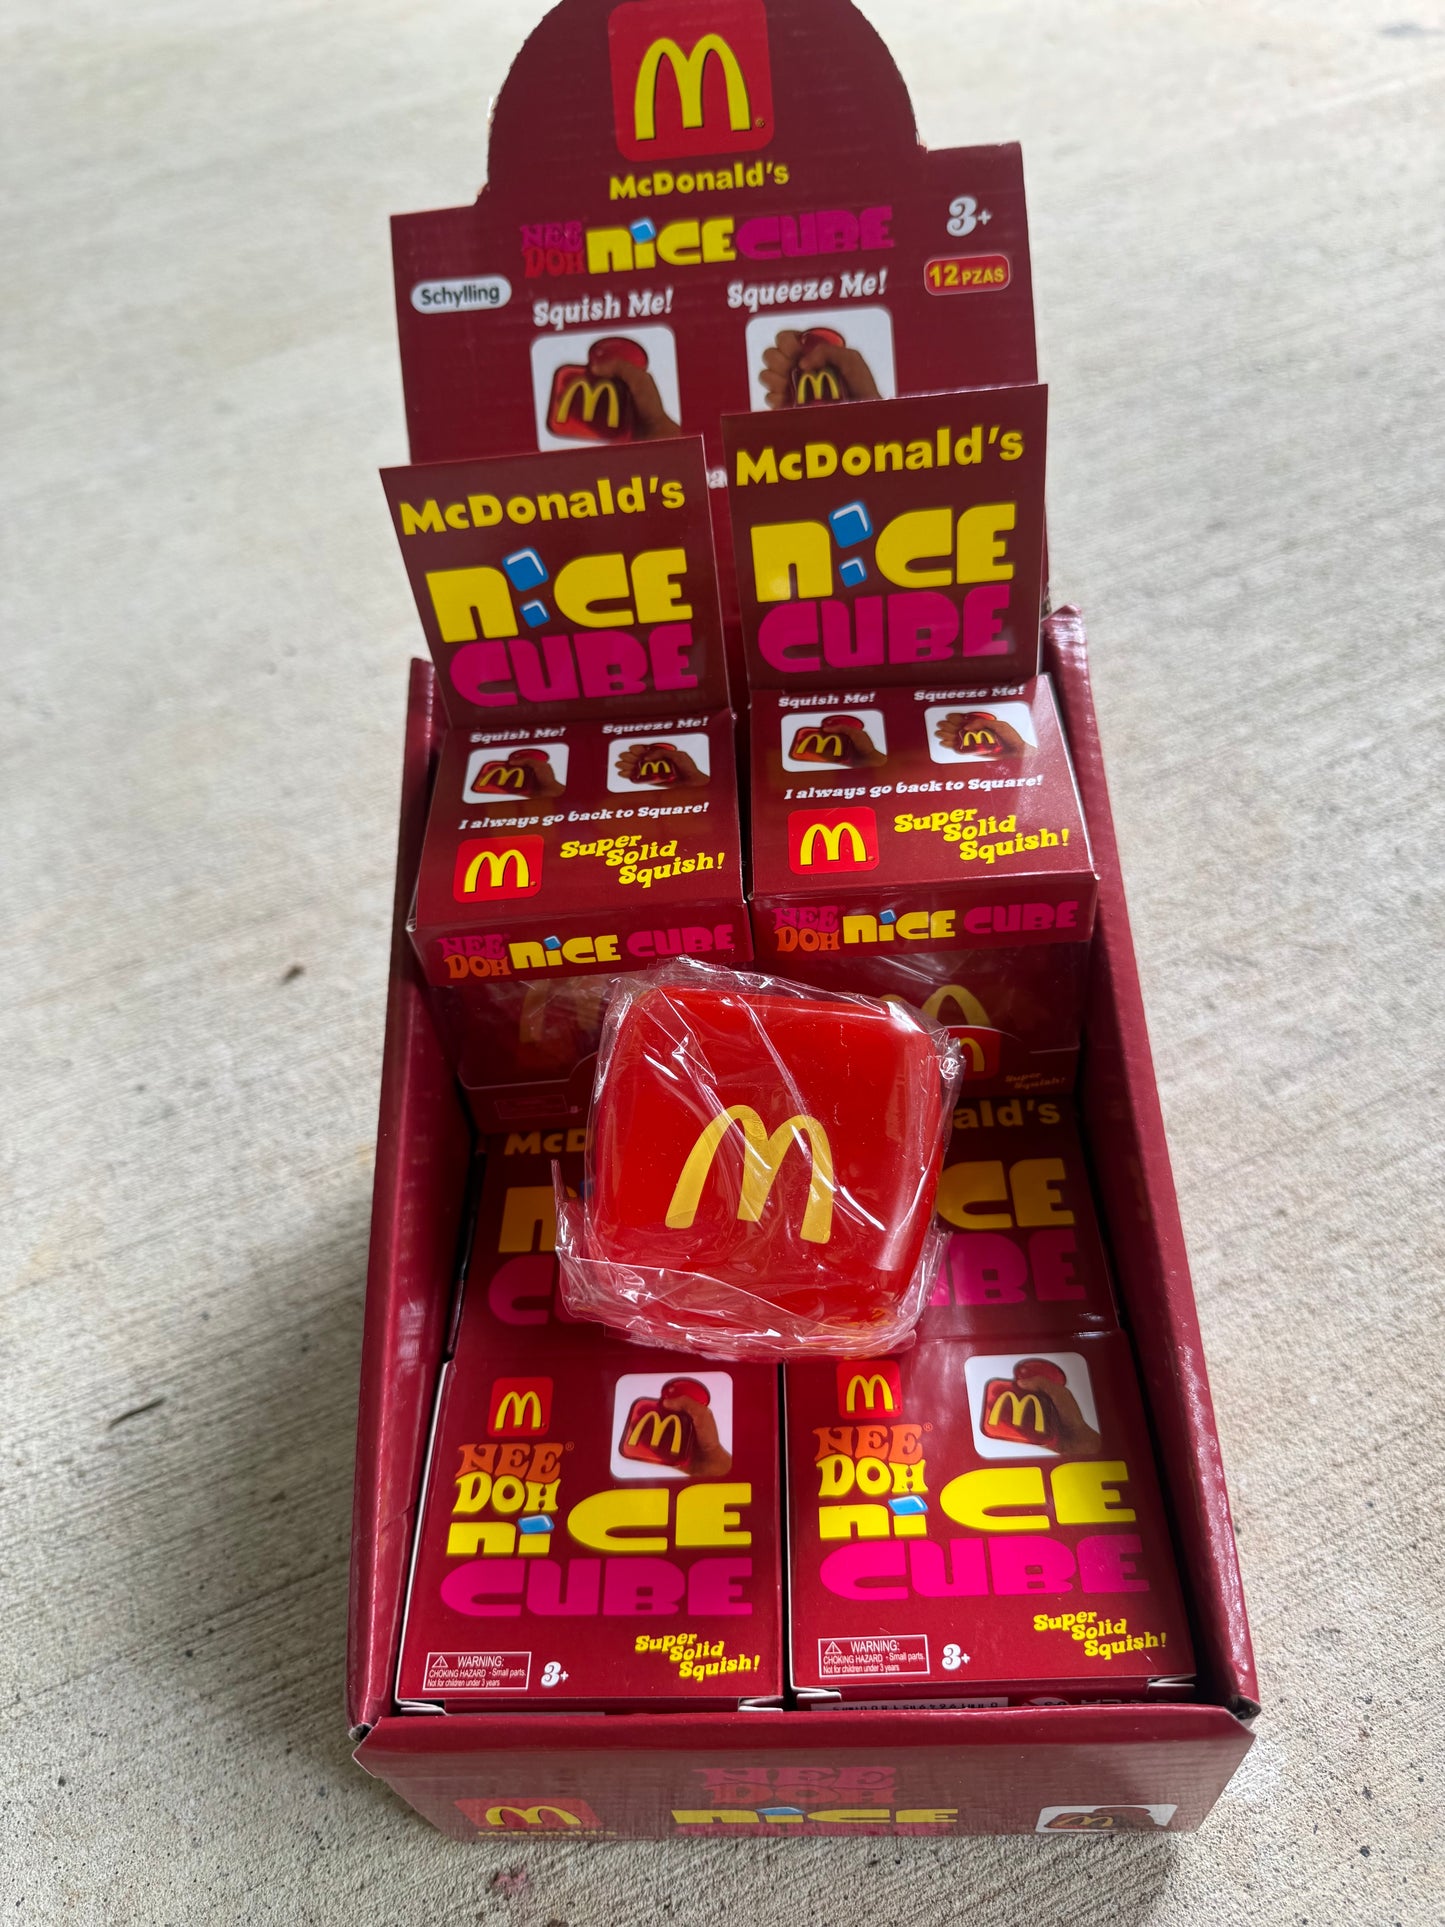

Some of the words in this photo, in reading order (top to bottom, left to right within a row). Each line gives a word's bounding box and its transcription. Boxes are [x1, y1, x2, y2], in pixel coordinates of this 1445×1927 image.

[609, 161, 790, 200] McDonald's
[947, 196, 992, 237] 3+
[520, 220, 583, 252] NEE
[735, 205, 896, 260] CUBE
[525, 247, 586, 278] DOH
[420, 283, 500, 308] Schylling
[727, 275, 834, 313] Squeeze
[839, 266, 888, 299] Me!
[533, 294, 622, 331] Squish
[627, 287, 674, 319] Me!
[735, 424, 1025, 487] McDonald's
[399, 473, 686, 536] McDonald's
[757, 584, 1012, 674] CUBE
[449, 623, 698, 708] CUBE
[778, 693, 840, 709] Squish
[842, 691, 876, 706] Me!
[913, 687, 989, 703] Squeeze
[992, 684, 1026, 698] Me!
[469, 729, 531, 745] Squish
[534, 725, 567, 740] Me!
[602, 719, 674, 736] Squeeze
[676, 715, 710, 730] Me!
[783, 788, 793, 800] I
[795, 784, 866, 801] always
[869, 784, 893, 799] go
[895, 780, 942, 795] back
[945, 780, 965, 792] to
[967, 774, 1044, 792] Square!
[458, 819, 469, 831] I
[470, 814, 539, 831] always
[542, 813, 565, 827] go
[567, 808, 613, 823] back
[615, 807, 635, 818] to
[637, 801, 710, 819] Square!
[894, 808, 978, 833] Super
[943, 815, 1017, 843] Solid
[560, 834, 642, 860] Super
[605, 840, 678, 868] Solid
[959, 828, 1070, 865] Squish!
[618, 852, 726, 889] Squish!
[771, 905, 840, 932] NEE
[963, 901, 1080, 934] CUBE
[436, 934, 509, 961] NEE
[626, 923, 736, 957] CUBE
[774, 926, 841, 952] DOH
[443, 954, 513, 979] DOH
[952, 1099, 1061, 1129] ald's
[937, 1157, 1076, 1230] CE
[812, 1423, 923, 1465] NEE
[455, 1443, 564, 1484] NEE
[816, 1453, 929, 1497] DOH
[451, 1471, 561, 1514] DOH
[819, 1534, 1150, 1600] CUBE
[440, 1557, 753, 1617] CUBE
[1033, 1610, 1097, 1632] Super
[1071, 1619, 1128, 1641] Solid
[634, 1632, 698, 1653] Super
[669, 1641, 725, 1663] Solid
[850, 1639, 900, 1653] WARNING:
[1083, 1632, 1167, 1661] Squish!
[457, 1655, 504, 1668] WARNING:
[678, 1655, 761, 1683] Squish!
[823, 1655, 854, 1665] CHOKING
[855, 1654, 883, 1664] HAZARD
[908, 1652, 925, 1663] parts.
[823, 1666, 833, 1674] Not
[842, 1665, 863, 1673] children
[864, 1664, 879, 1672] under
[884, 1664, 900, 1673] years
[942, 1643, 971, 1671] 3+
[427, 1679, 436, 1687] Not
[436, 1679, 444, 1687] for
[445, 1679, 465, 1687] children
[466, 1679, 480, 1687] under
[485, 1679, 500, 1688] years
[428, 1669, 458, 1678] CHOKING
[460, 1669, 486, 1677] HAZARD
[509, 1669, 526, 1678] parts.
[540, 1661, 569, 1687] 3+
